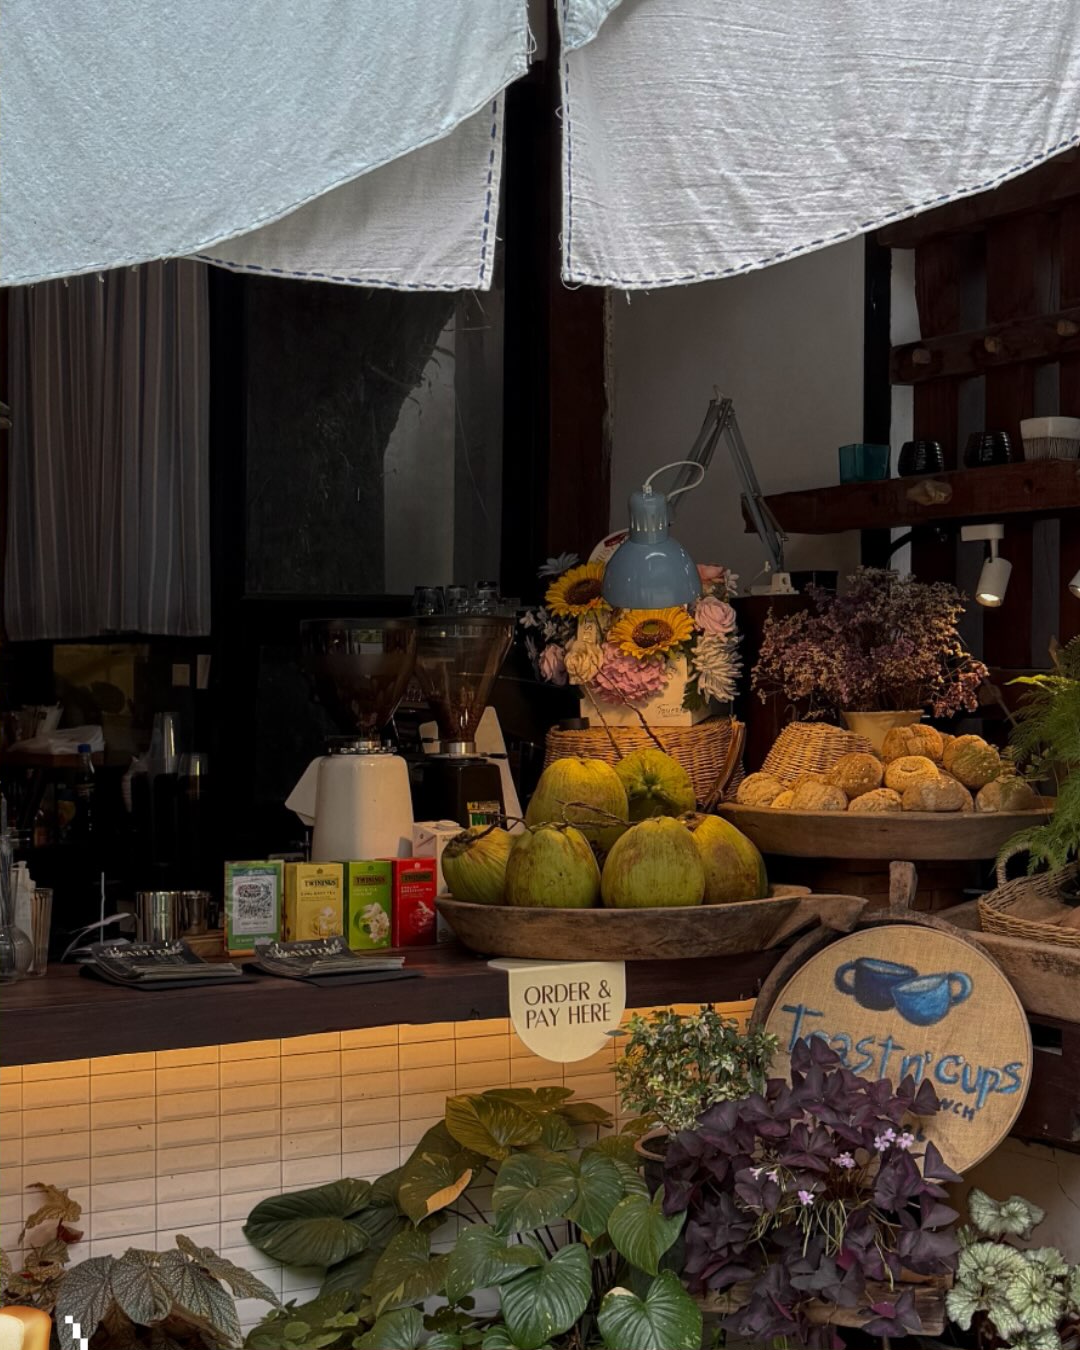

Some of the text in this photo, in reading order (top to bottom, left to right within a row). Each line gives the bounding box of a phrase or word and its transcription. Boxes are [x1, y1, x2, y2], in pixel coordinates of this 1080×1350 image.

[524, 979, 612, 1006] ORDER &
[526, 1002, 612, 1029] PAY HERE
